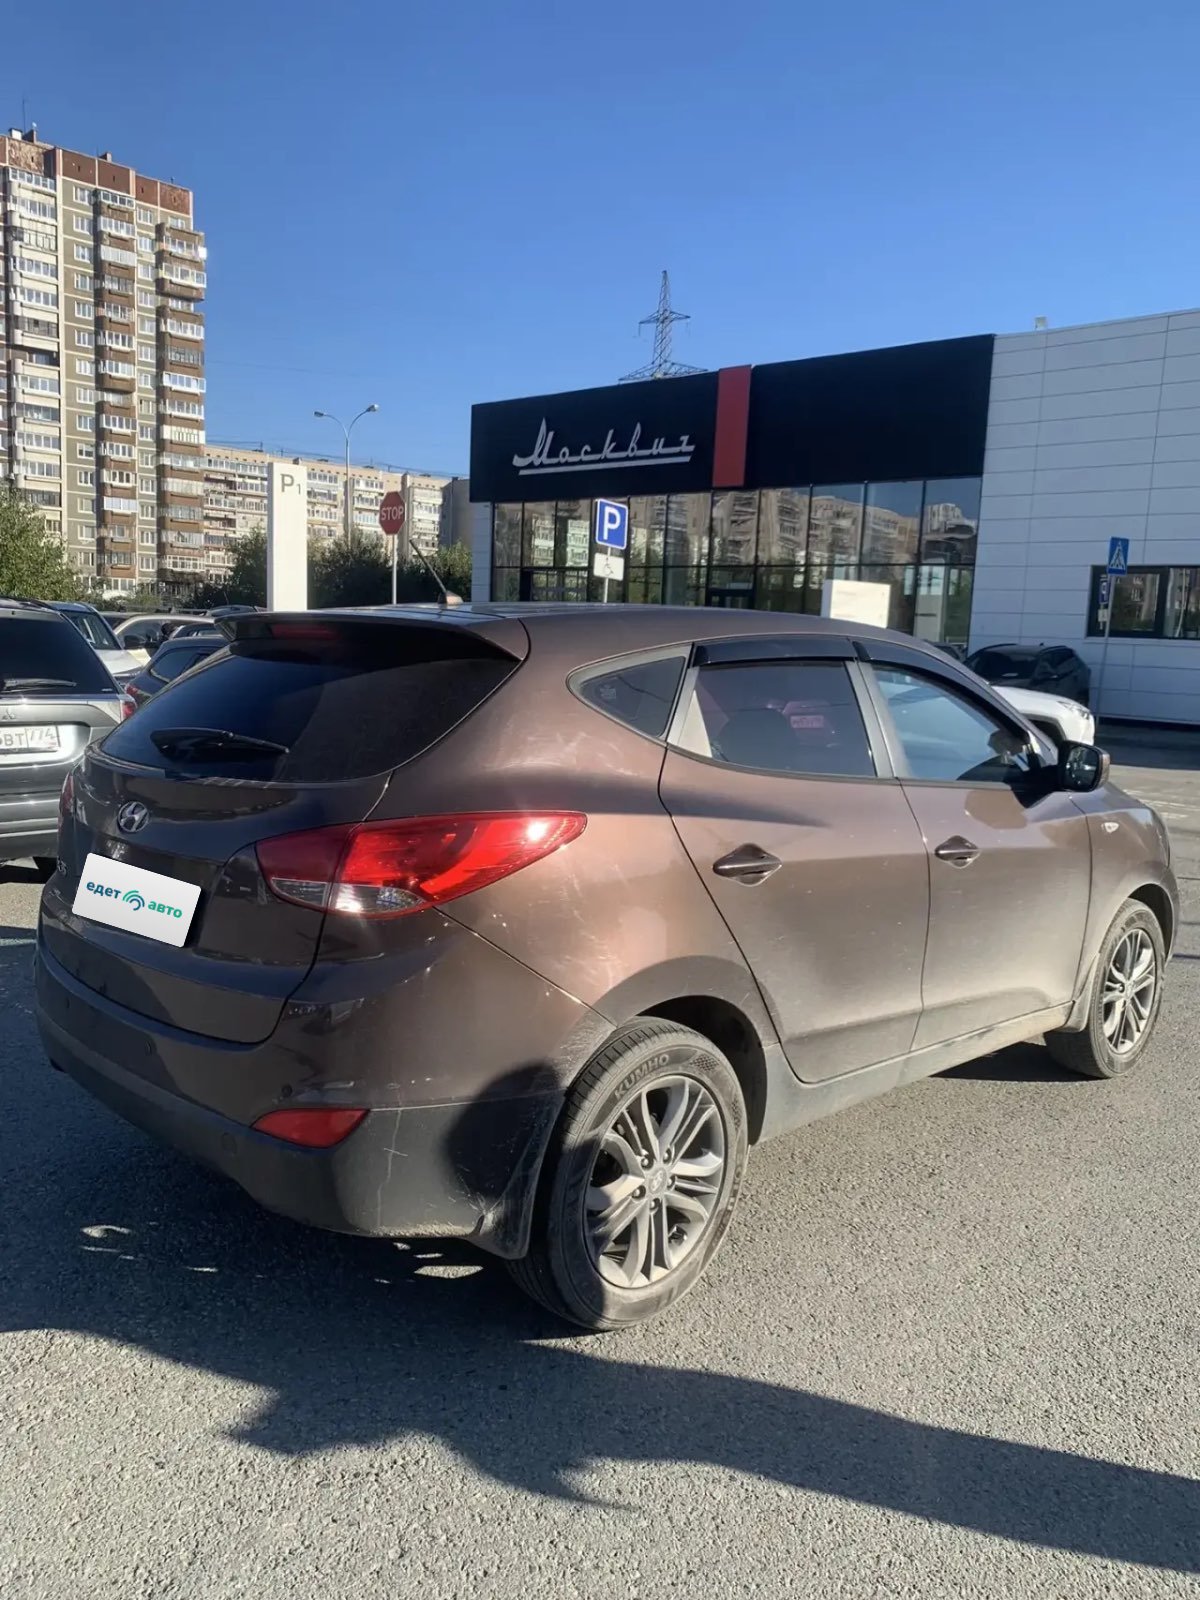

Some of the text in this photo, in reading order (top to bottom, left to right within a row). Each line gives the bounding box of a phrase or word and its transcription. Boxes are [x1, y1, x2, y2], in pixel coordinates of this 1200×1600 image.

[381, 506, 404, 521] STOP
[603, 506, 621, 540] P
[614, 1053, 669, 1100] KUMHO
